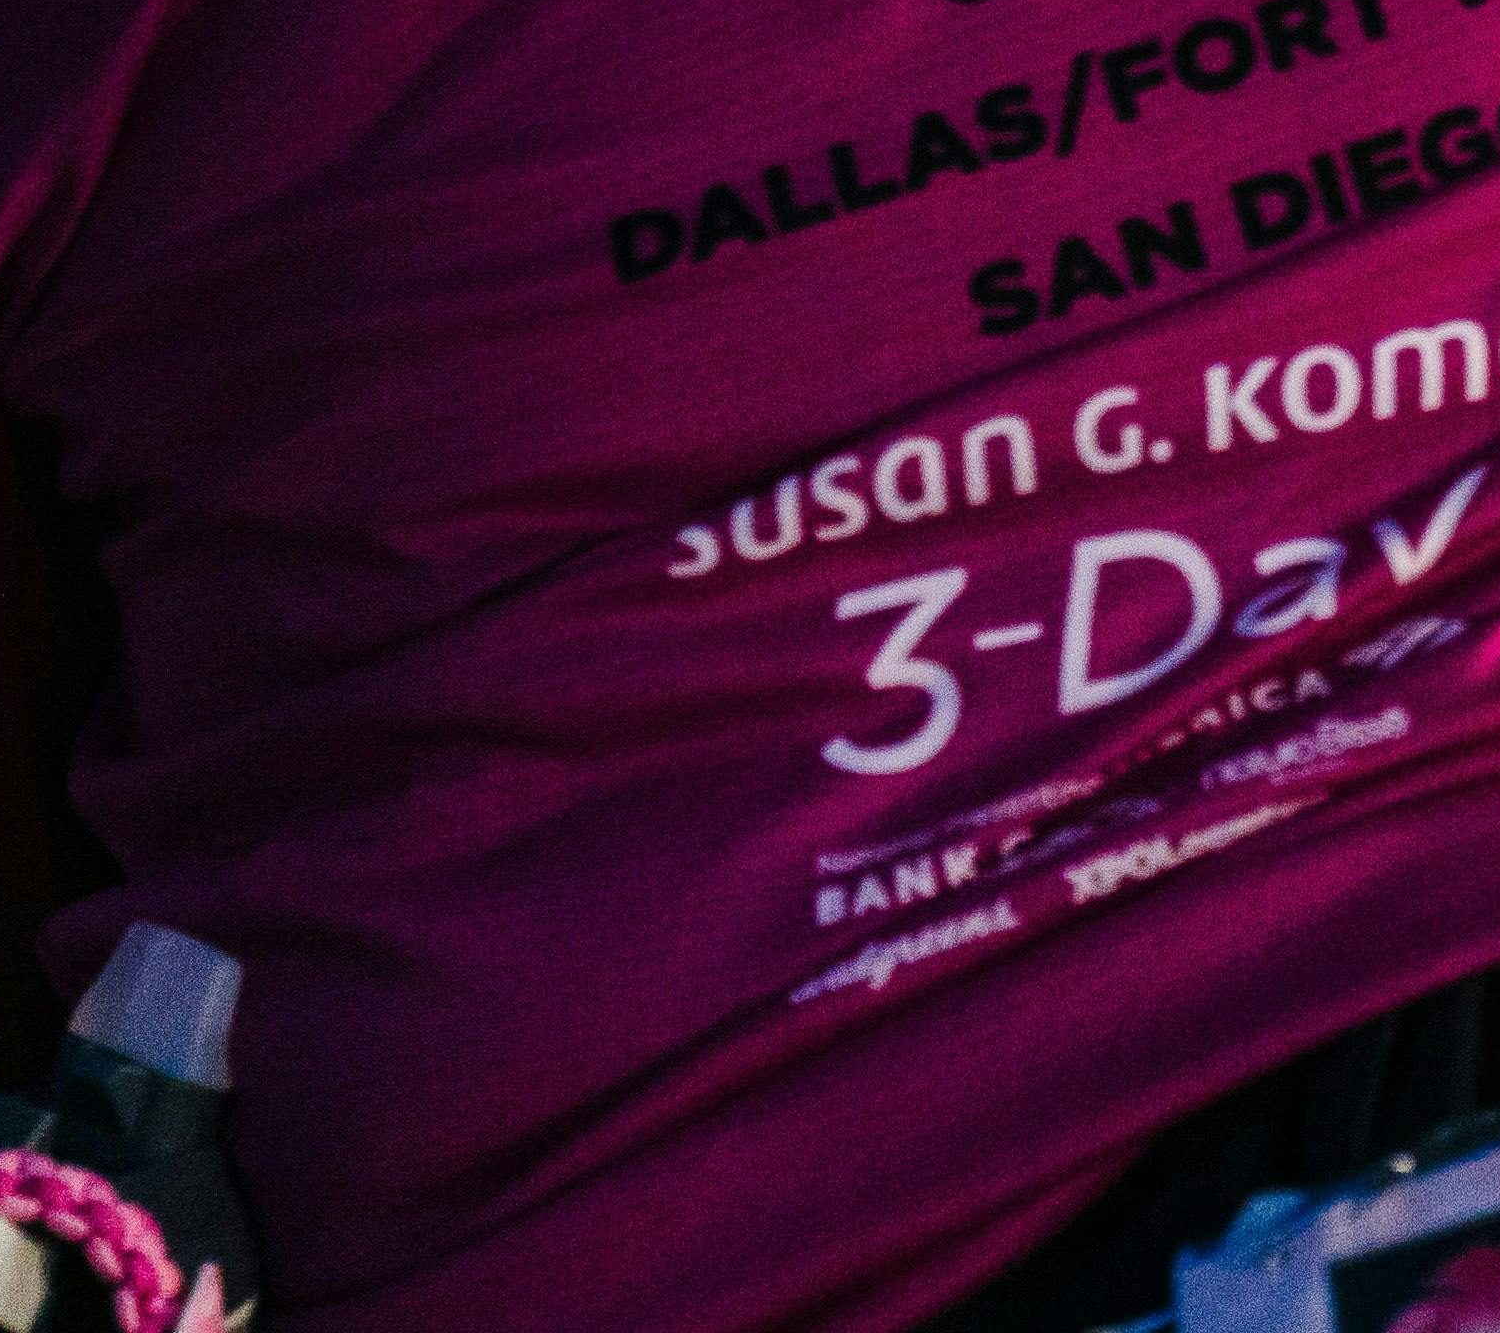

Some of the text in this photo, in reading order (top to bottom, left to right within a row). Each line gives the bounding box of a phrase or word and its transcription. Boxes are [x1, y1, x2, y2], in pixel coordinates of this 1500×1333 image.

[967, 201, 1208, 335] SAN
[1073, 386, 1175, 475] G.
[814, 840, 980, 927] BANK
